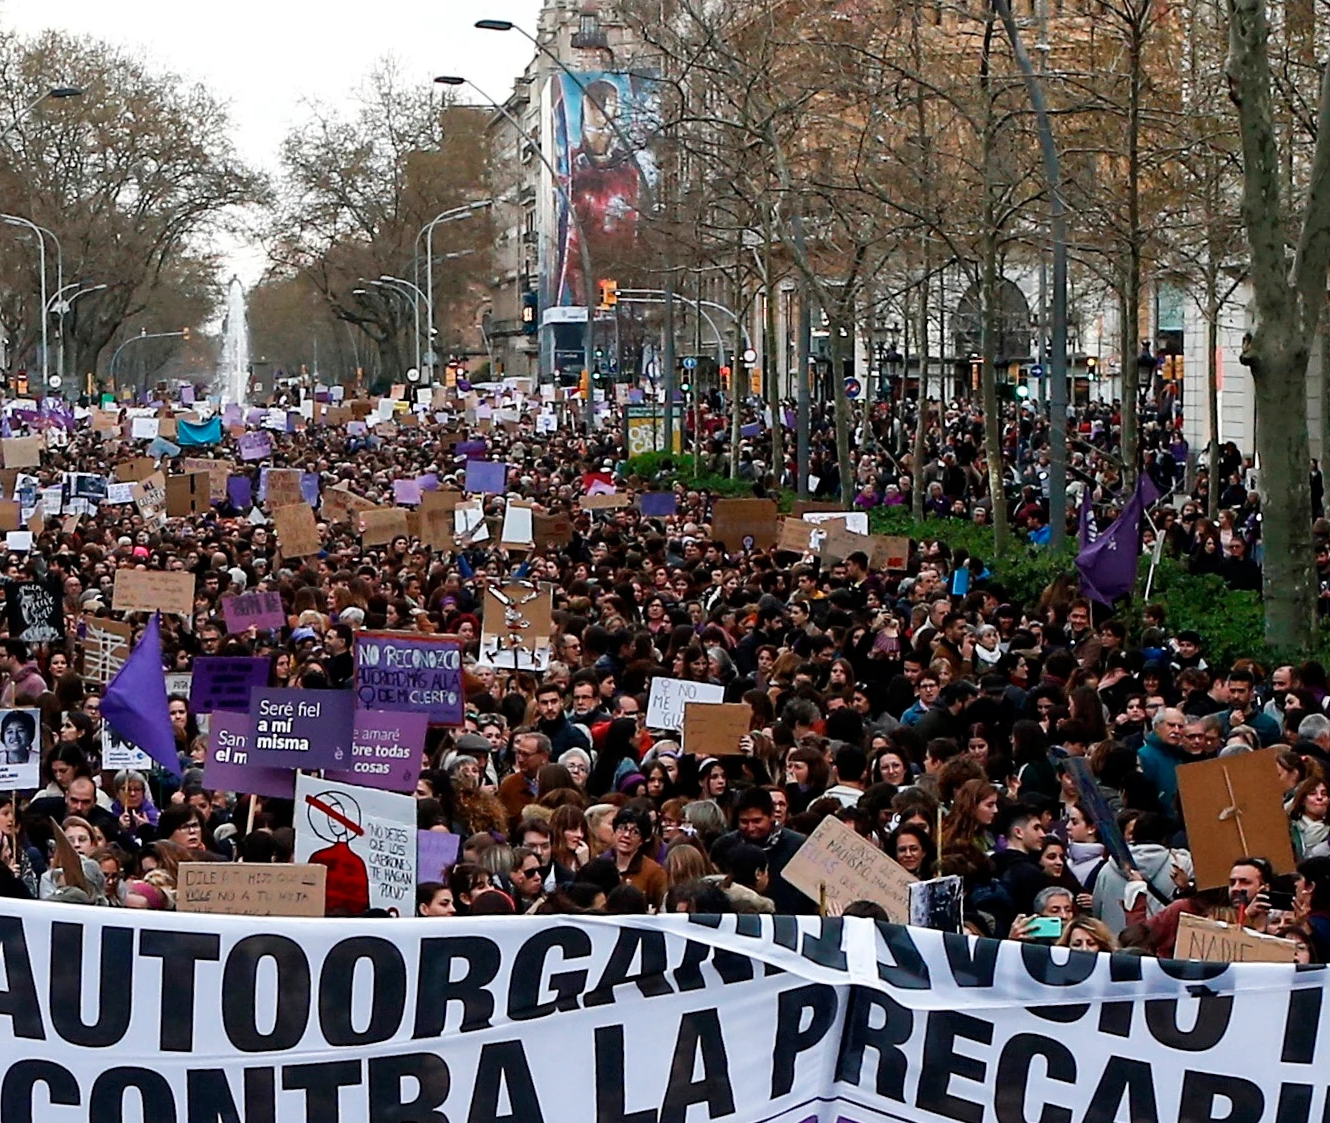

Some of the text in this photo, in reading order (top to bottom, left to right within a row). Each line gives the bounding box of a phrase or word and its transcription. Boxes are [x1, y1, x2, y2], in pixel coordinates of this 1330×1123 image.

[359, 644, 460, 670] NO RECONOZCO
[409, 690, 457, 706] CUERPO
[677, 684, 697, 698] NO
[259, 699, 321, 718] Seré fiel
[257, 718, 293, 732] a mí
[218, 731, 248, 746] San
[256, 735, 310, 751] misma
[361, 728, 400, 742] amaré
[216, 748, 247, 764] el m
[352, 741, 411, 758] bre todas
[354, 762, 391, 774] cosas
[370, 839, 387, 853] QUE
[369, 851, 413, 873] CABRONES
[185, 871, 217, 886] DILE
[370, 865, 413, 886] TE HAGAN
